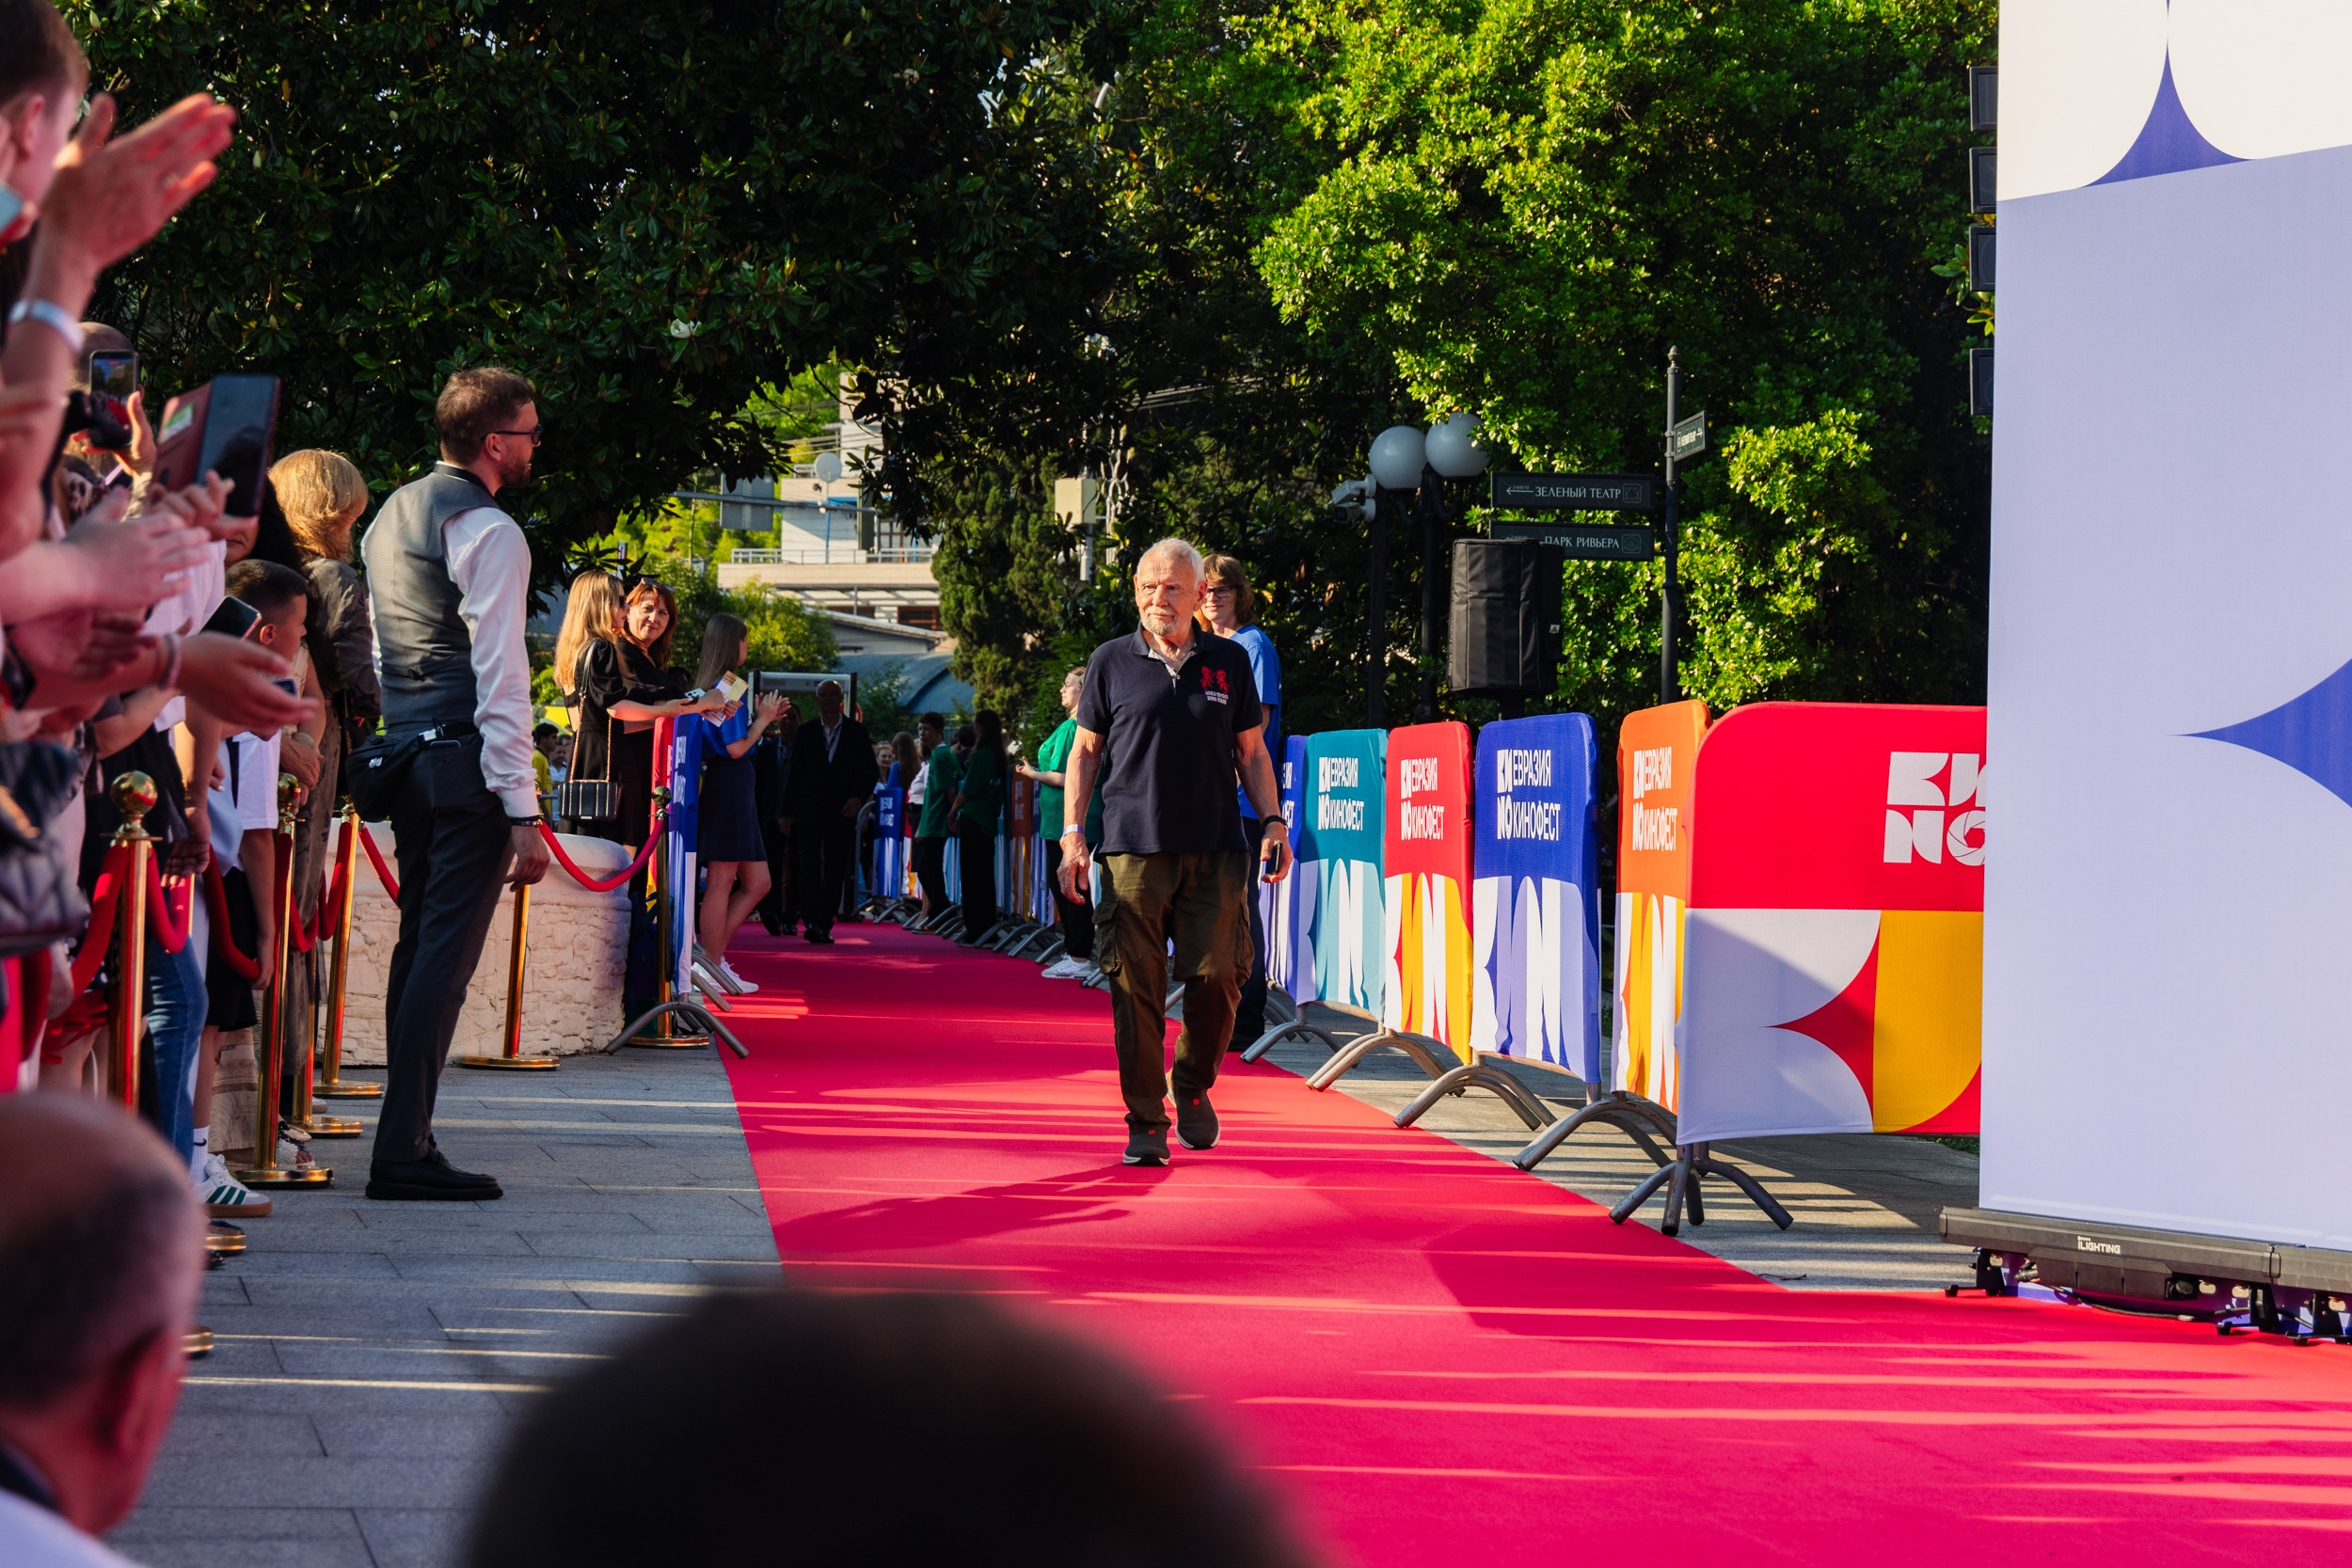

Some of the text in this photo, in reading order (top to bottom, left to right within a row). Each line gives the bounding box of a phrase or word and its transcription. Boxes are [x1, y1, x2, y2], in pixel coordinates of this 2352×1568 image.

[1534, 486, 1621, 499] ЗЕЛЕНЫЙ ТЕАТР
[1545, 536, 1620, 548] ПАРК РИВЬЕРА
[1330, 757, 1359, 787] ЕВРАЗИЯ
[1411, 757, 1438, 792] ЕВРАЗИЯ
[1513, 749, 1551, 787] ЕВРАЗИЯ
[1645, 746, 1672, 791] ЕВРАЗИЯ
[1329, 799, 1364, 831] КИНОФЕСТ
[1411, 804, 1444, 840] КИНОФЕСТ
[1513, 800, 1561, 841] КИНОФЕСТ
[1644, 806, 1677, 852] КИНОФЕСТ
